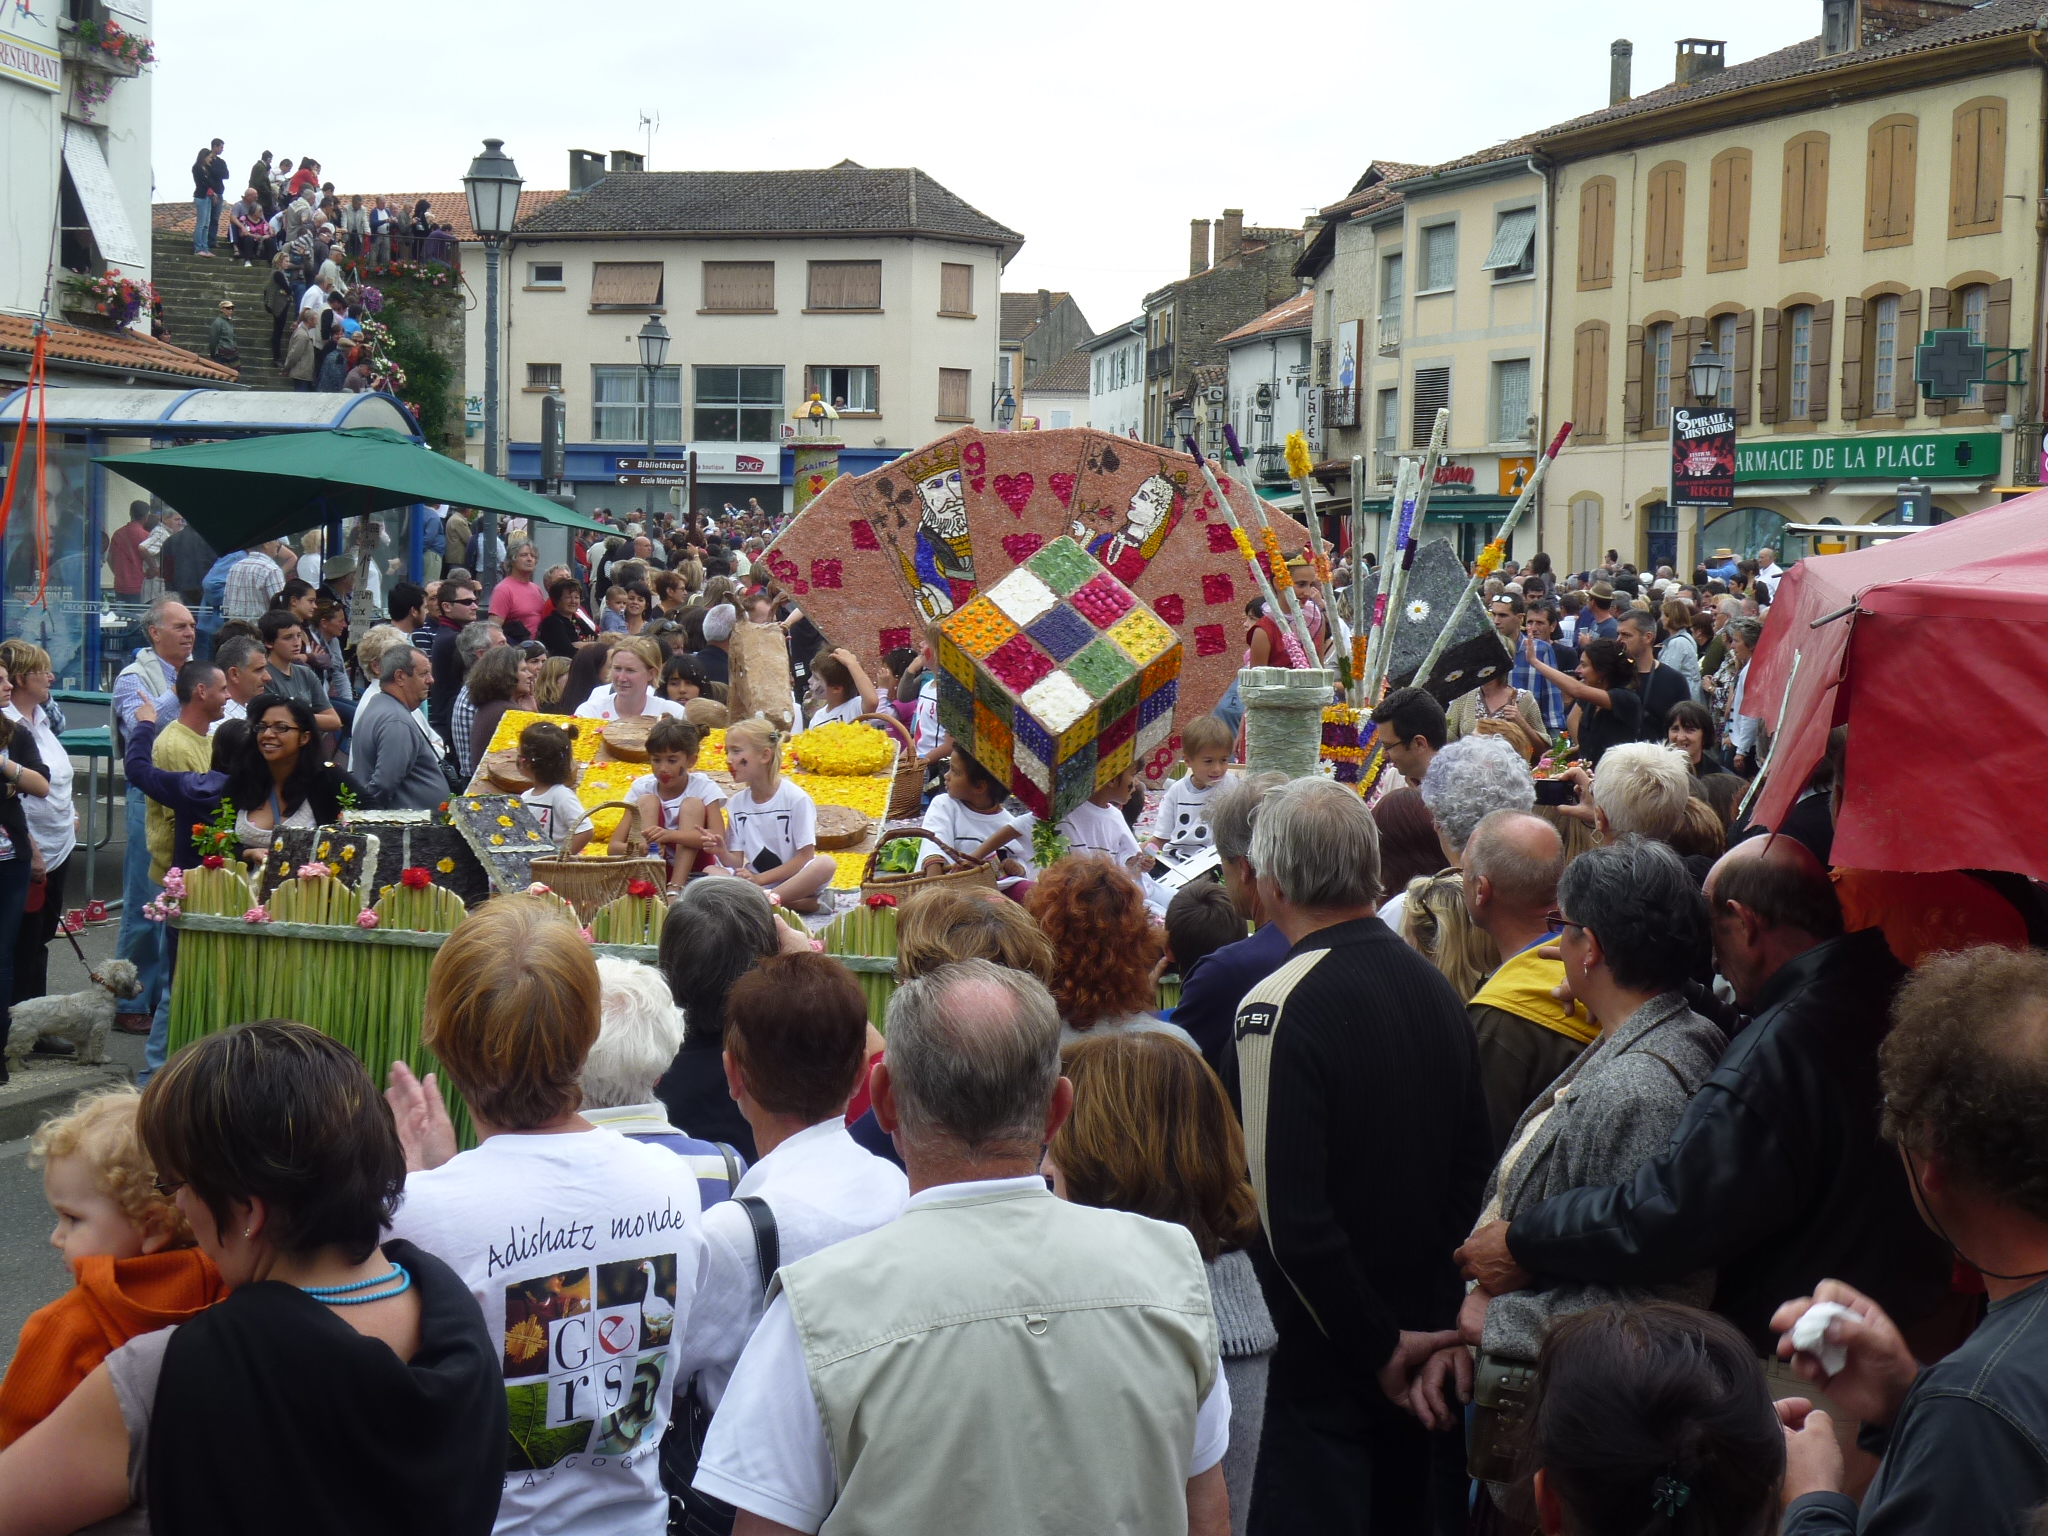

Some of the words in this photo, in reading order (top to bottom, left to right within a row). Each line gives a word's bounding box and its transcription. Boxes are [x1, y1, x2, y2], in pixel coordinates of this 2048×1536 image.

[0, 41, 60, 82] RESTAURANT
[1675, 410, 1726, 431] SPIRALE
[1684, 422, 1734, 439] HISTOIRES
[637, 460, 685, 469] Bibliothèque
[804, 460, 829, 471] SAINT
[963, 441, 986, 476] 9
[1734, 449, 1804, 472] ARMACIE
[1813, 447, 1835, 469] DE
[1844, 446, 1866, 469] LA
[1876, 443, 1937, 468] PLACE
[737, 462, 763, 471] SNCF
[640, 476, 655, 485] Ecole
[656, 476, 685, 485] Maternelle
[1689, 485, 1732, 497] RISCLE
[63, 603, 98, 611] PROCITY
[737, 816, 747, 832] 7
[777, 815, 790, 834] 7
[488, 1216, 597, 1278] Adishatz
[611, 1196, 685, 1240] monde
